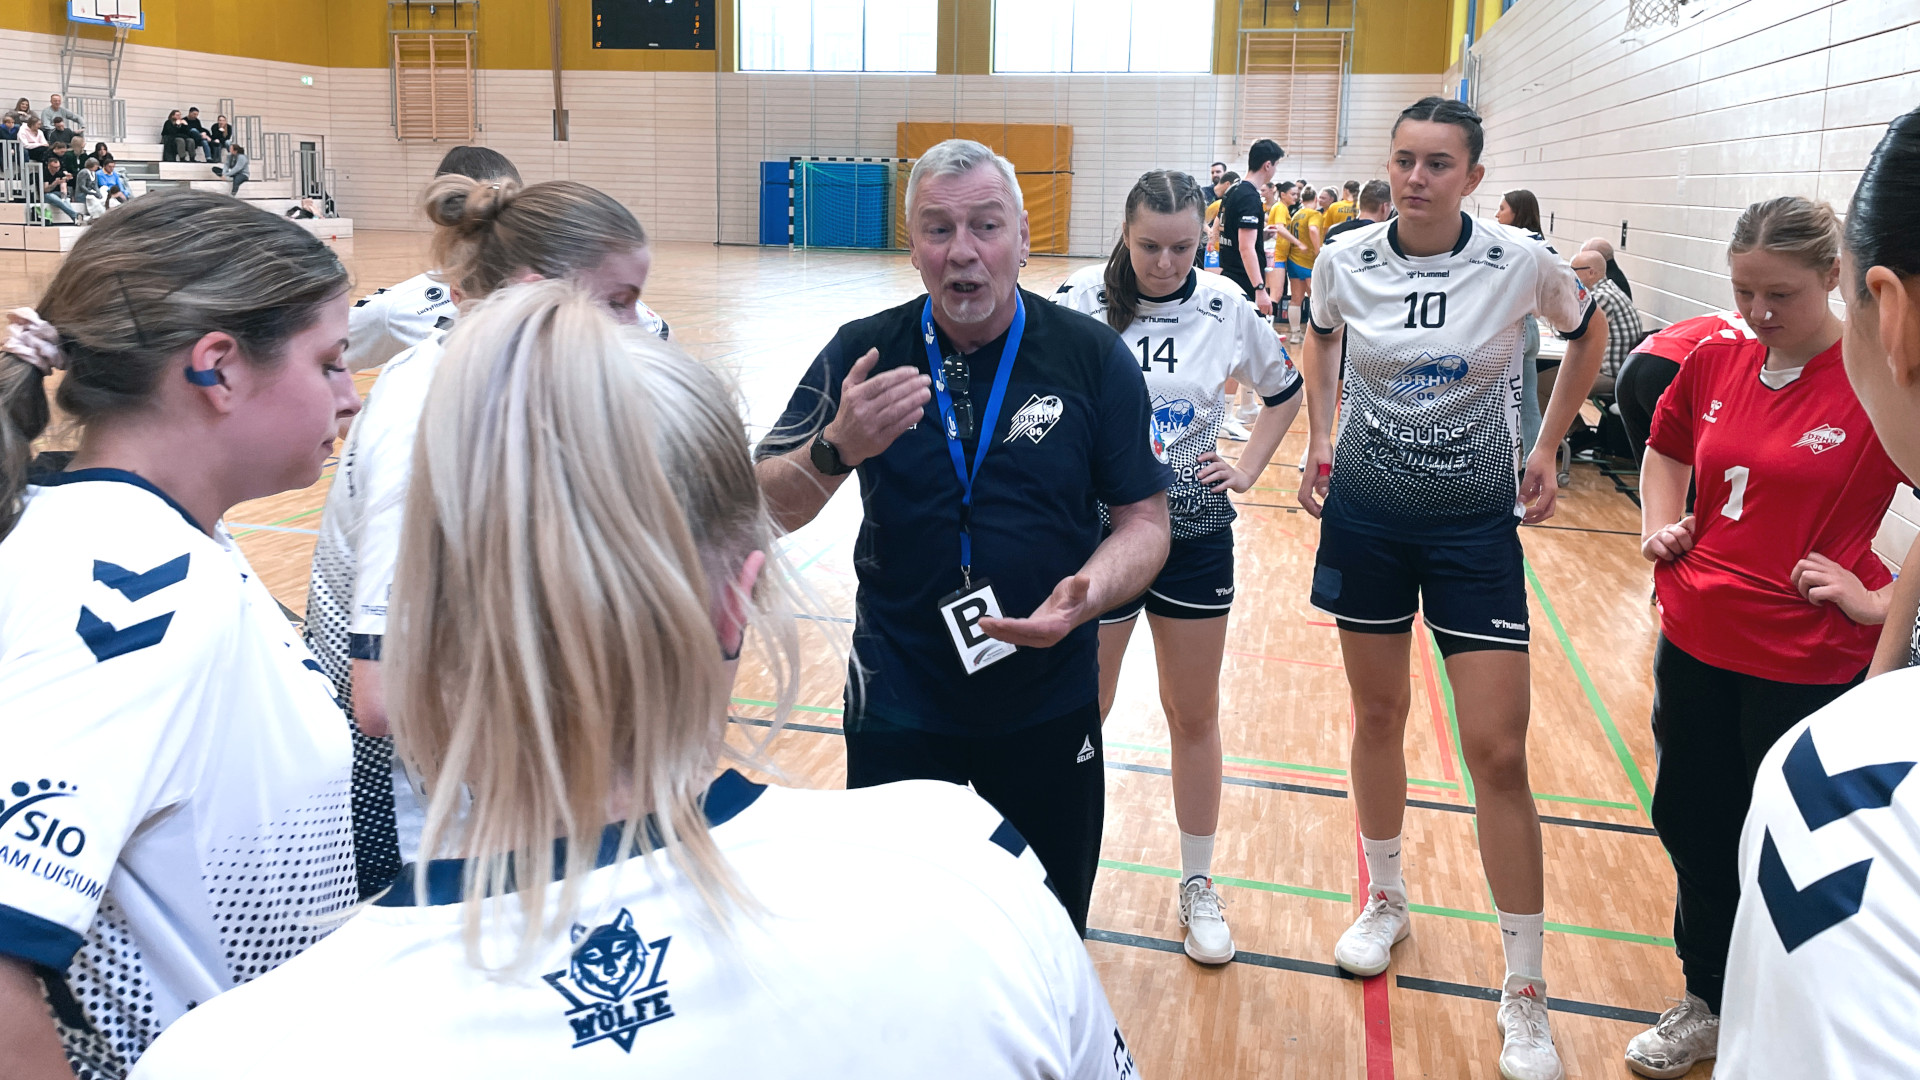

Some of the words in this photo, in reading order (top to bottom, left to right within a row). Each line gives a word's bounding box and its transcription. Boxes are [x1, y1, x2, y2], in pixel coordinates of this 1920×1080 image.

[1417, 270, 1450, 279] hummel
[1403, 291, 1447, 329] 10
[1148, 315, 1179, 324] hummel
[1136, 336, 1178, 374] 14
[1400, 373, 1456, 388] DRHV
[1416, 391, 1436, 401] 06
[1018, 414, 1055, 424] DRHV
[1029, 427, 1044, 436] 06
[1159, 421, 1183, 434] HV
[1807, 433, 1838, 445] DRHV
[1812, 443, 1824, 451] 06
[1720, 465, 1750, 521] 1
[951, 597, 994, 649] B
[1076, 750, 1095, 764] SELECT
[14, 810, 87, 858] SIO
[31, 857, 104, 901] LUISIUM
[568, 989, 672, 1042] WÖLFE
